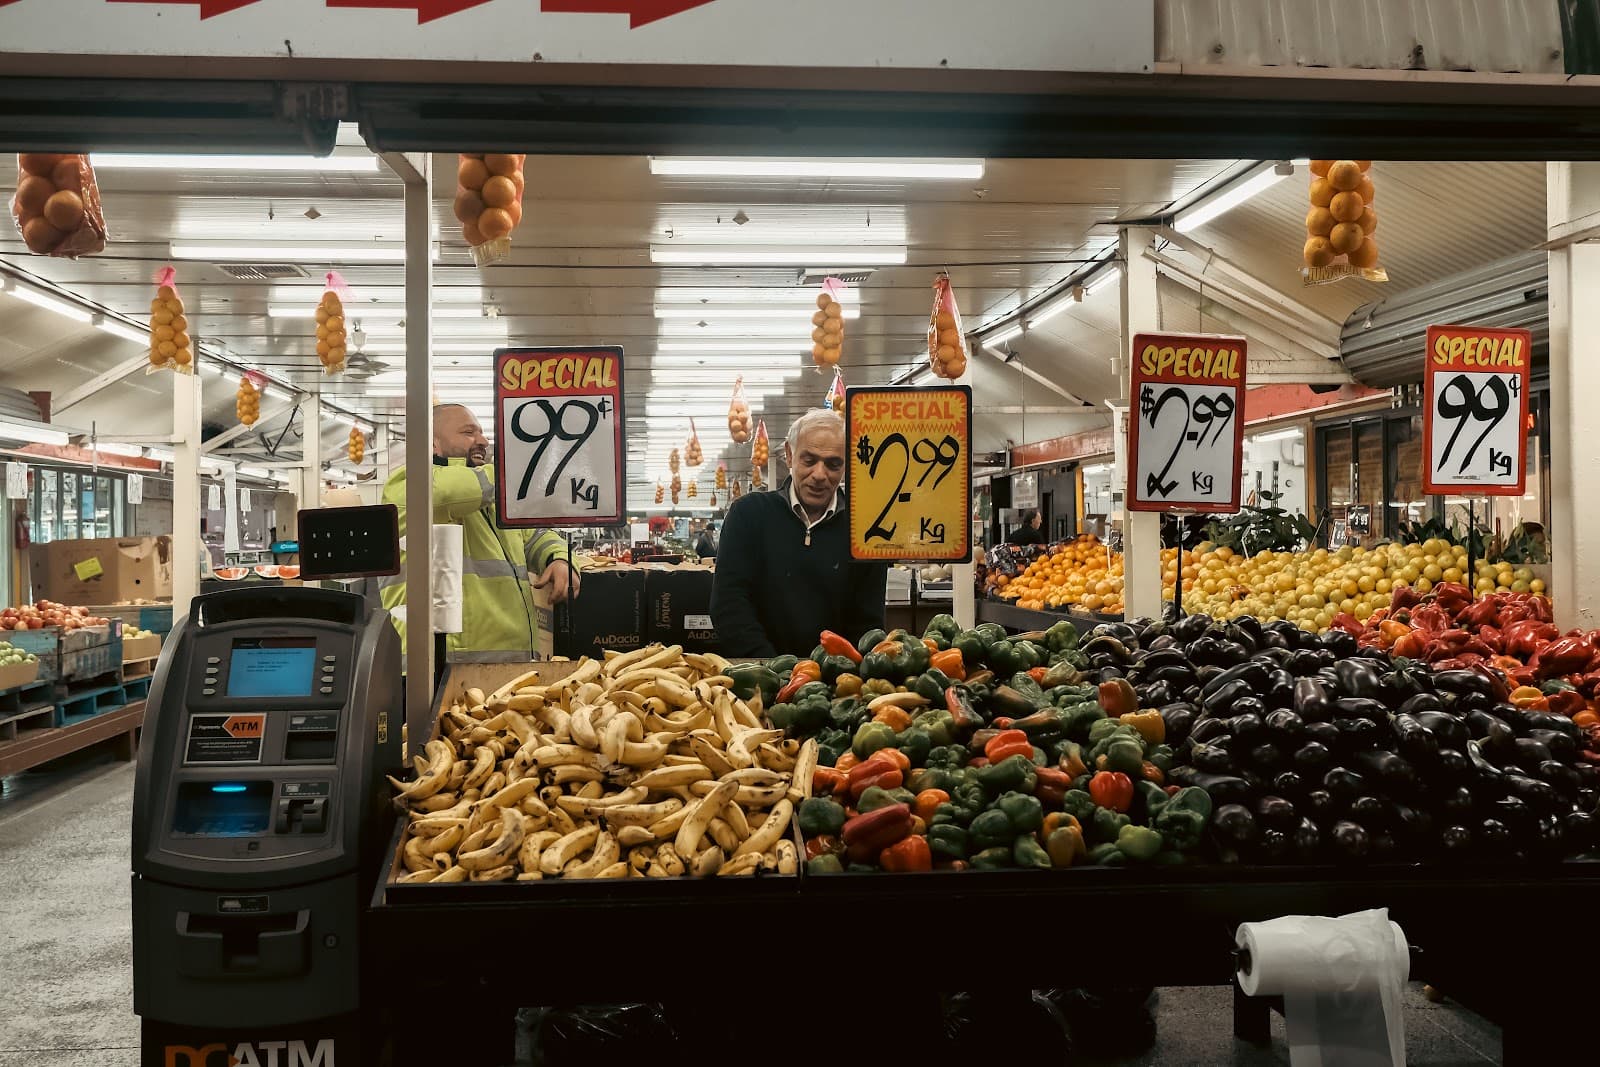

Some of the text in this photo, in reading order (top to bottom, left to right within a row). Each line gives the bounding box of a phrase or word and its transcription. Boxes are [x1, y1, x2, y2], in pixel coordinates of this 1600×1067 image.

[1139, 344, 1240, 380] SPECIAL
[1433, 334, 1525, 367] SPECIAL
[501, 357, 617, 391] SPECIAL
[863, 400, 955, 421] SPECIAL
[1489, 447, 1512, 477] Kg
[571, 477, 599, 510] Kg
[1192, 470, 1214, 495] Kg
[920, 516, 945, 544] Kg
[593, 633, 640, 645] AuDacia
[231, 721, 259, 731] ATM
